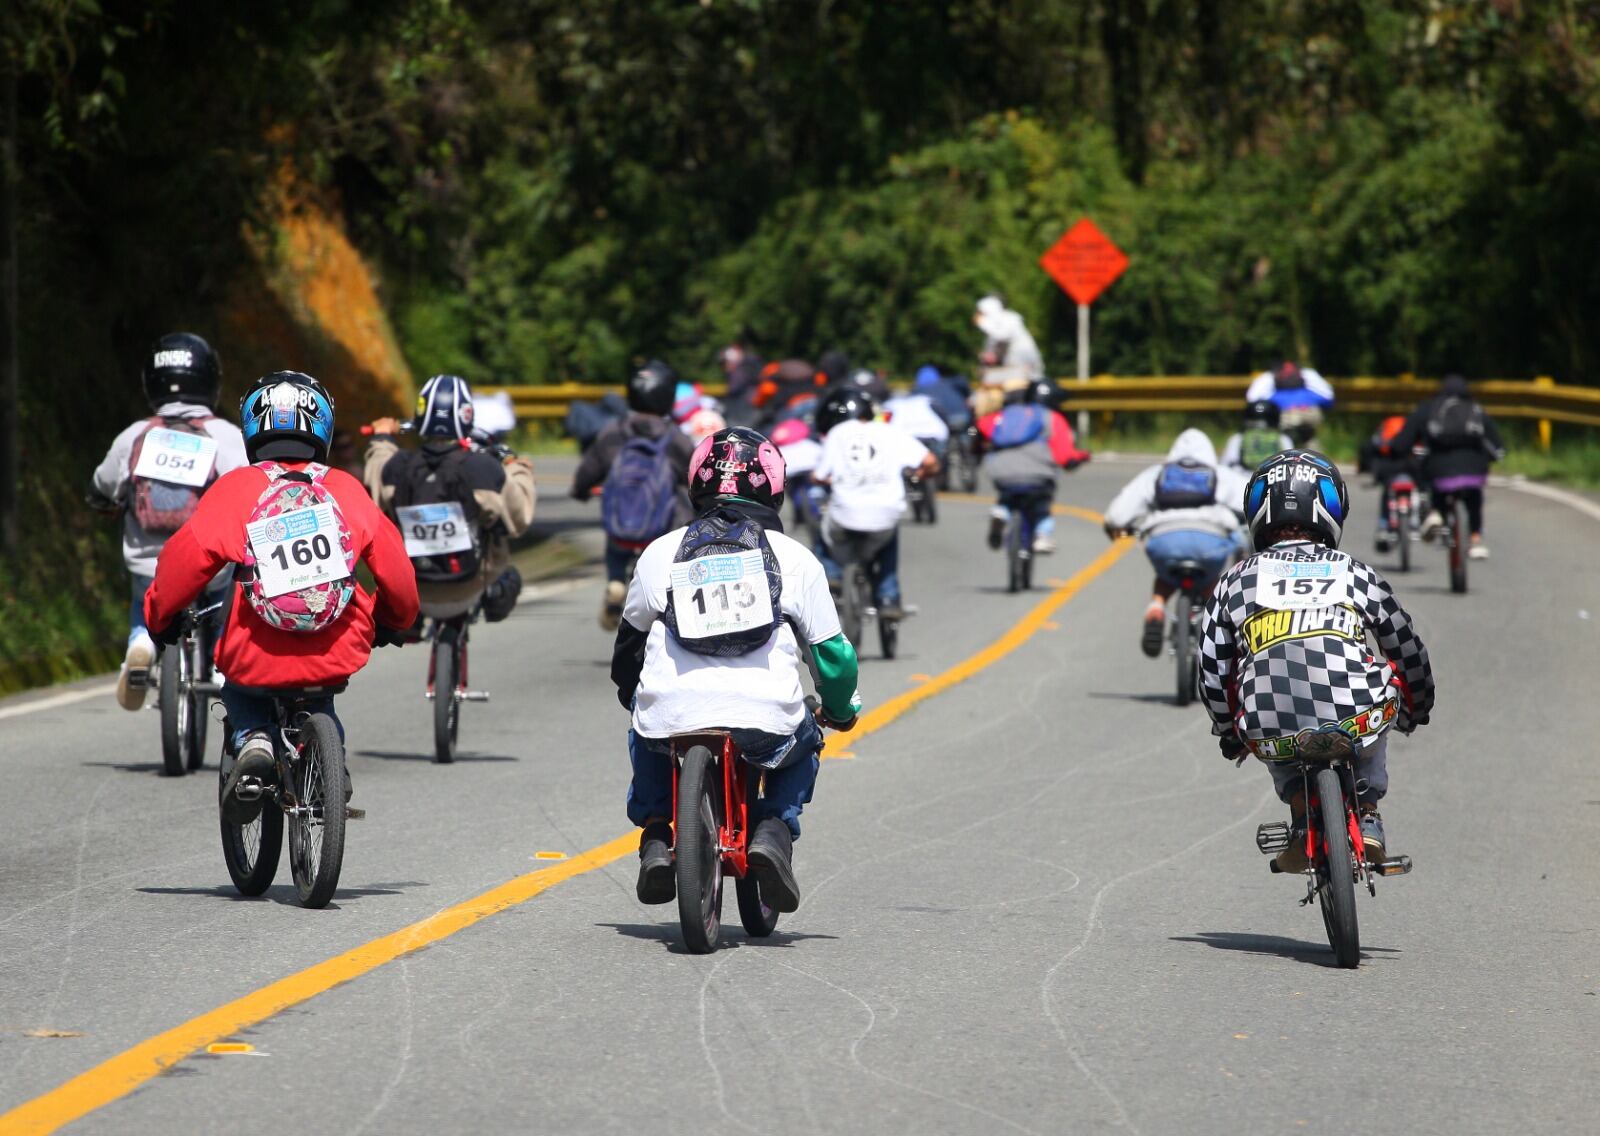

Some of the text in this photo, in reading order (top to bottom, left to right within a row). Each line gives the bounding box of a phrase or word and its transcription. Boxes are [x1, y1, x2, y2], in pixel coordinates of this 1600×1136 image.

[155, 453, 195, 470] 054
[412, 521, 456, 540] 079
[271, 534, 331, 571] 160
[1272, 579, 1336, 596] 157
[691, 582, 756, 615] 113
